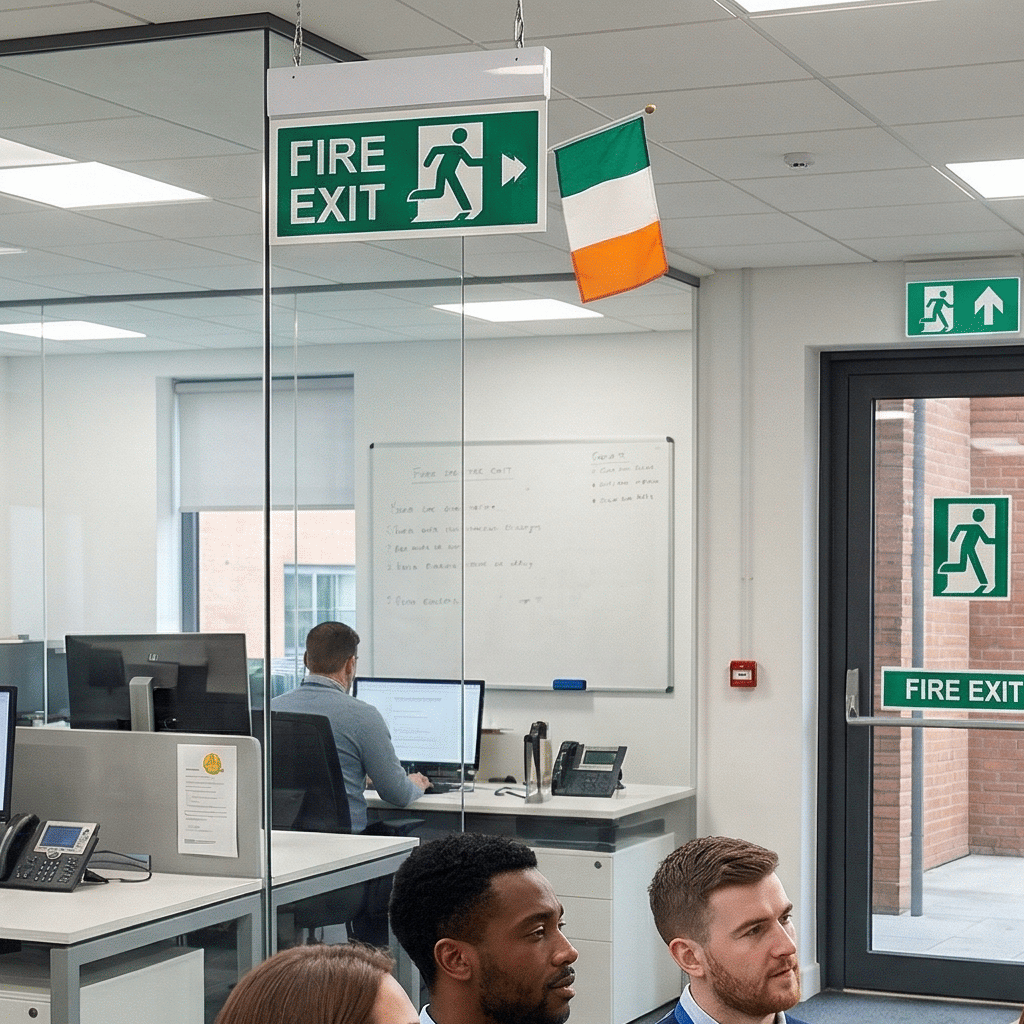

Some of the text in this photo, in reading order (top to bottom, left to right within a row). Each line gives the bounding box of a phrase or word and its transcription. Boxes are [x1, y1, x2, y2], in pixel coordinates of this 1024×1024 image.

[290, 135, 386, 177] FIRE
[290, 183, 386, 225] EXIT
[905, 678, 1024, 703] FIRE EXIT
